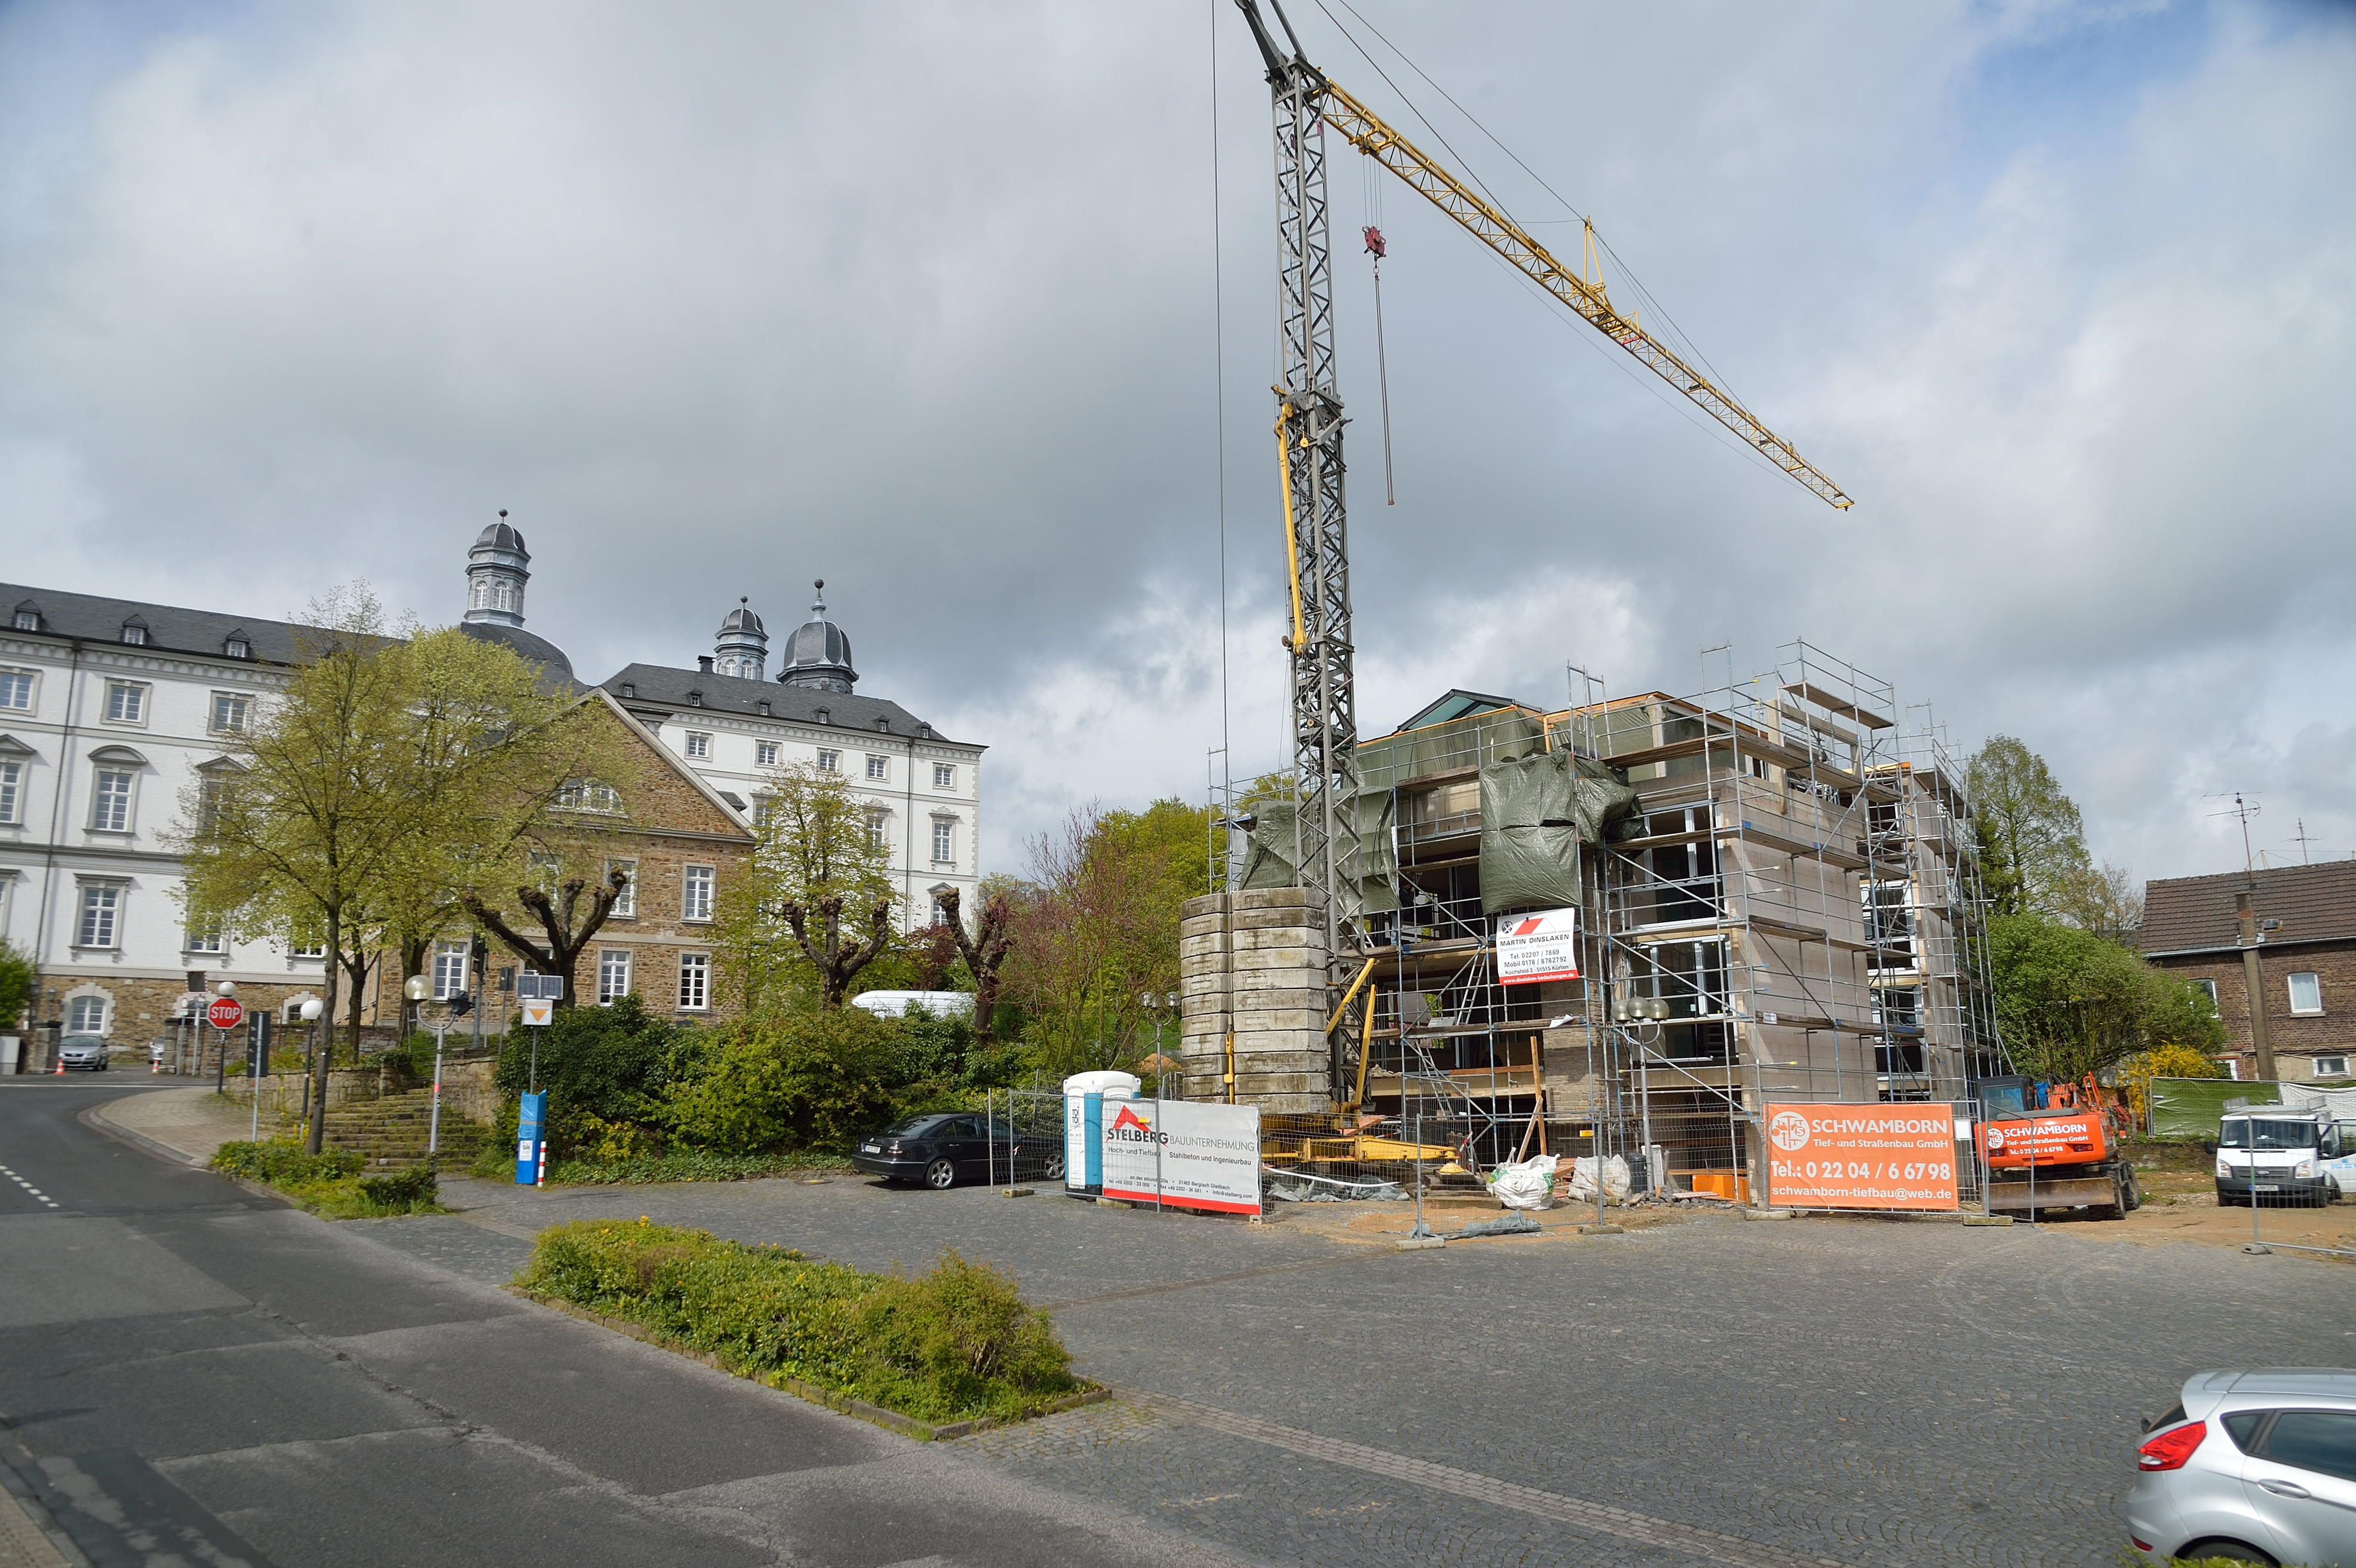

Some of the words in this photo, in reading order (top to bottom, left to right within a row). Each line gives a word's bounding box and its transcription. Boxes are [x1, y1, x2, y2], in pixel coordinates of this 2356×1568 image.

[1500, 938, 1526, 947] MARTIN
[1529, 934, 1569, 944] DINSLAKEN
[1503, 972, 1574, 984] www.dinslaken-bedachungen.de
[210, 1006, 240, 1019] STOP
[1811, 1119, 1948, 1134] SCHWAMBORN
[2004, 1123, 2087, 1137] SCHWAMBORN
[1107, 1127, 1169, 1144] STELBERG
[1170, 1136, 1255, 1152] BAUUNTERNEHMUNG
[1813, 1138, 1835, 1147] Tief-
[1837, 1139, 1855, 1148] und
[1858, 1139, 1914, 1149] Straßenbau
[1916, 1139, 1948, 1148] GmbH
[2033, 1136, 2067, 1144] Straßenbau
[1169, 1152, 1200, 1161] Stahlbeton
[1213, 1156, 1252, 1166] Ingenieurbau
[1771, 1159, 1802, 1178] Tel.:
[1806, 1161, 1817, 1178] 0
[1821, 1161, 1843, 1179] 22
[1848, 1162, 1870, 1179] 04
[1875, 1162, 1883, 1179] /
[1888, 1163, 1900, 1179] 6
[1772, 1185, 1952, 1200] schwamborn-tiefbau@web.de
